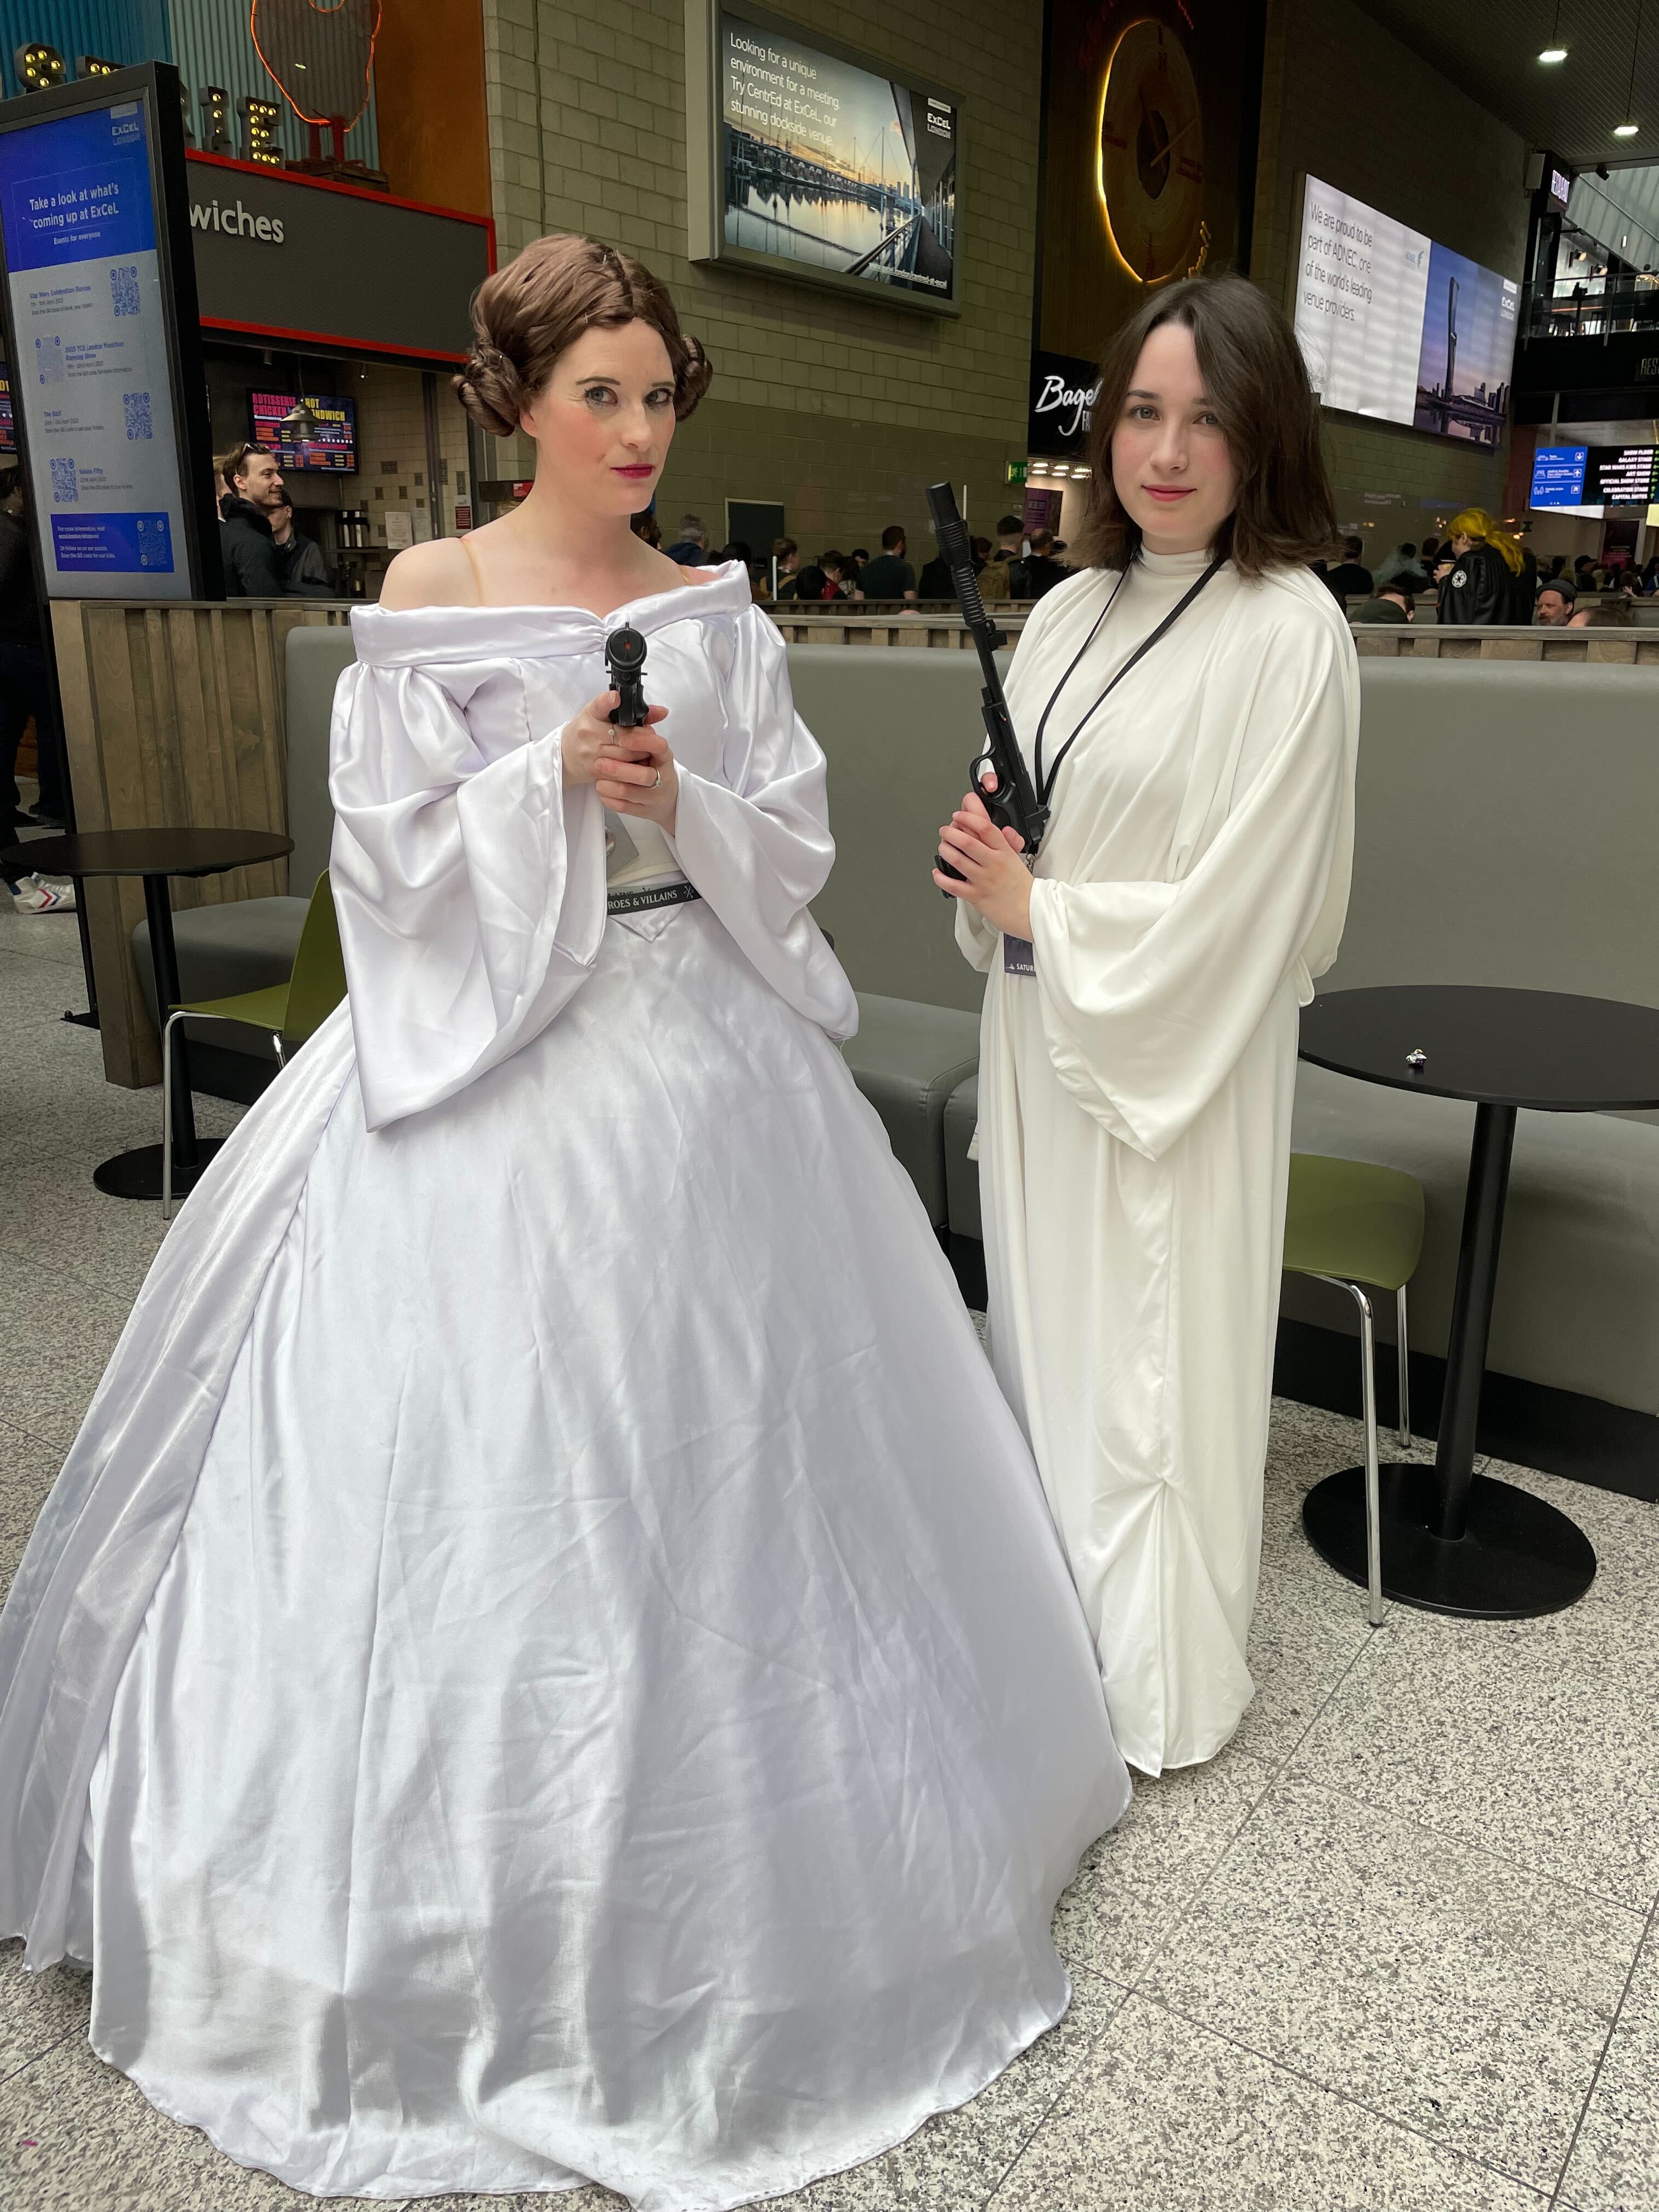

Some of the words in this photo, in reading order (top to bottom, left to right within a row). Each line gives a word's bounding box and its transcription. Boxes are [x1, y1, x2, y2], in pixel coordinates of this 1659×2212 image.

[730, 32, 766, 61] Looking
[768, 48, 780, 65] for
[782, 57, 787, 67] a
[789, 60, 817, 80] unique
[730, 58, 785, 88] environment
[786, 76, 798, 92] for
[800, 84, 805, 95] a
[731, 76, 744, 95] Try
[747, 83, 782, 107] CentrEd
[783, 98, 792, 111] at
[794, 100, 822, 123] ExCeL,
[823, 114, 838, 127] our
[731, 100, 768, 125] stunning
[770, 113, 806, 137] dockside
[30, 197, 48, 211] Take
[51, 197, 56, 207] a
[58, 190, 77, 205] look
[79, 188, 88, 201] at
[91, 183, 119, 199] what's
[33, 213, 64, 229] coming
[66, 212, 77, 224] up
[80, 208, 88, 220] at
[91, 202, 119, 218] ExCeL
[54, 236, 70, 245] Events
[78, 232, 101, 240] everyone
[189, 200, 284, 243] wiches
[1311, 201, 1322, 223] We
[1324, 213, 1335, 229] are
[1335, 219, 1355, 239] proud
[1357, 227, 1363, 242] to
[1364, 228, 1372, 247] be
[1307, 235, 1323, 253] part
[1324, 240, 1332, 255] of
[1332, 243, 1357, 271] ADNEC,
[1359, 258, 1372, 274] one
[1304, 291, 1324, 310] venue
[1306, 261, 1314, 276] of
[1315, 263, 1326, 283] the
[1327, 272, 1348, 292] world's
[1350, 276, 1372, 304] leading
[253, 404, 287, 417] CHICKEN
[305, 398, 320, 409] HOT
[608, 898, 631, 910] ROES
[633, 898, 640, 906] &
[640, 890, 678, 905] VILLAINS
